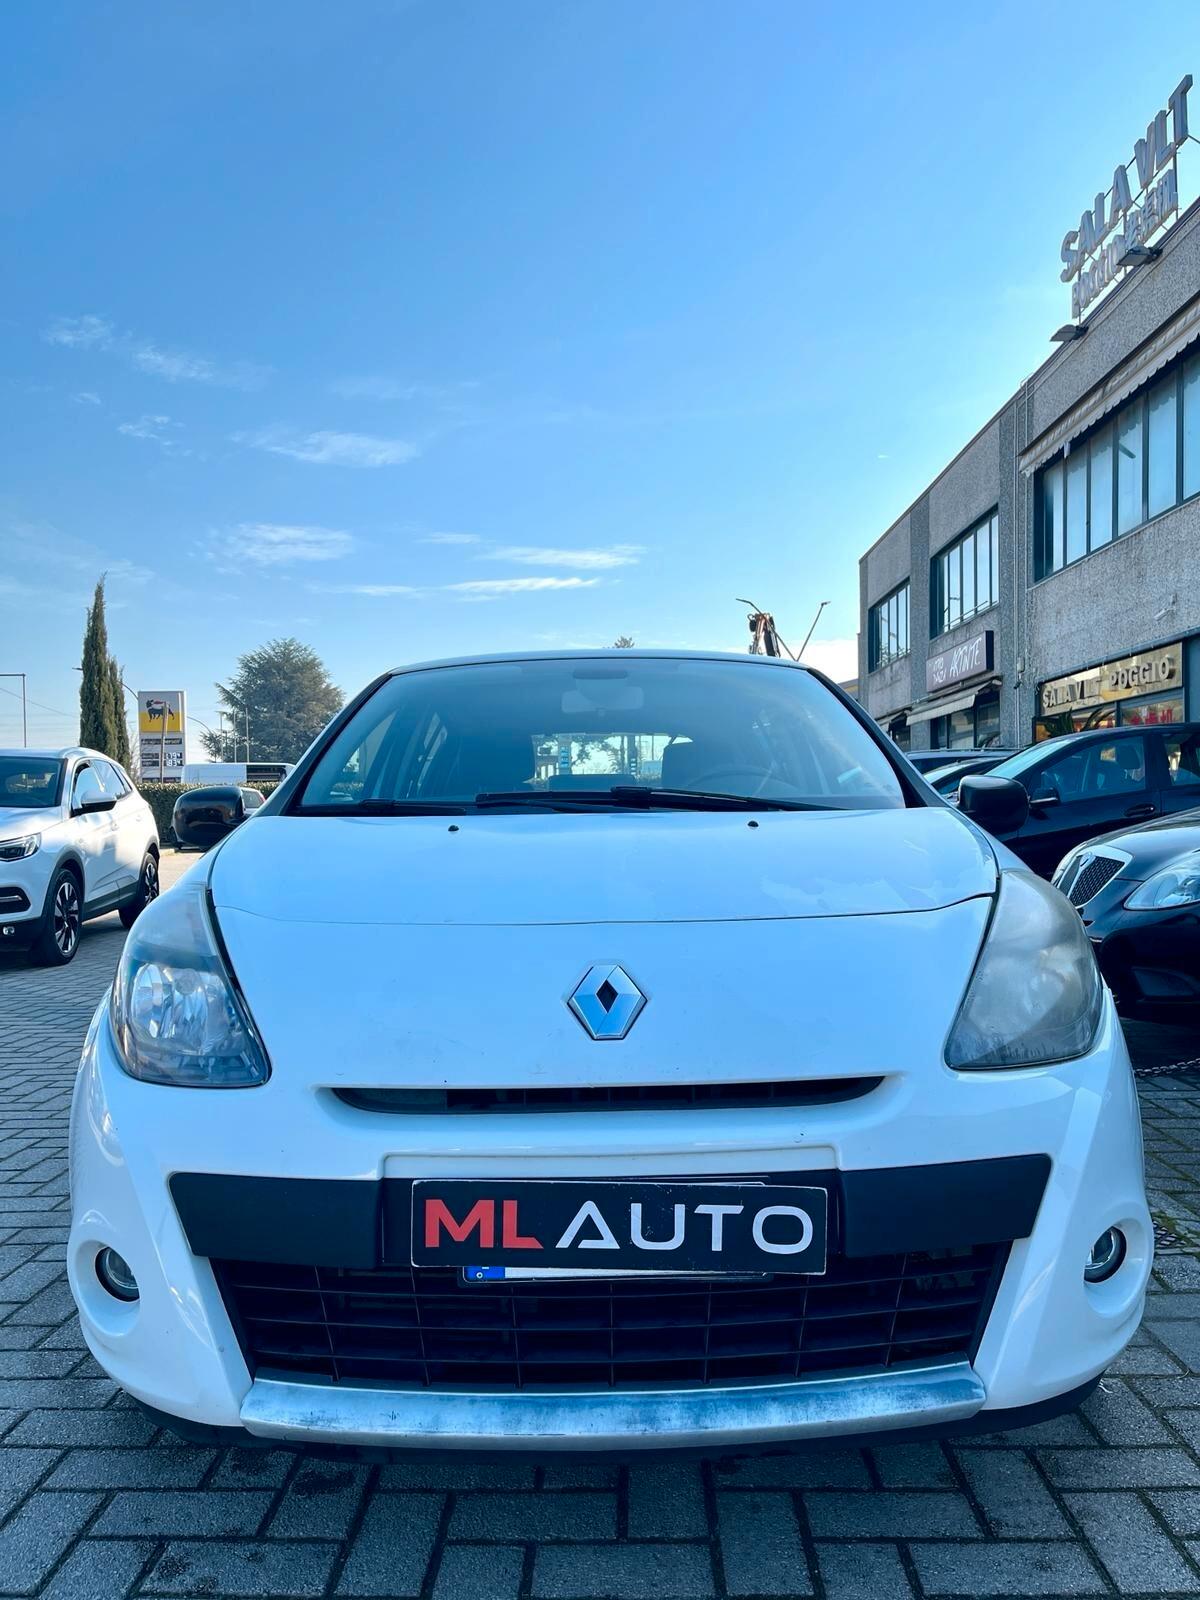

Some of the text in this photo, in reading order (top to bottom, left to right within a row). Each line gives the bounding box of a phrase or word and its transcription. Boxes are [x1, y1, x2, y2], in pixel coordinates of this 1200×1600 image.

[1060, 165, 1134, 283] SALA
[1134, 74, 1193, 190] VLT
[1043, 683, 1073, 709] SALA
[1109, 656, 1171, 691] POGGIO
[425, 1199, 813, 1255] ML AUTO
